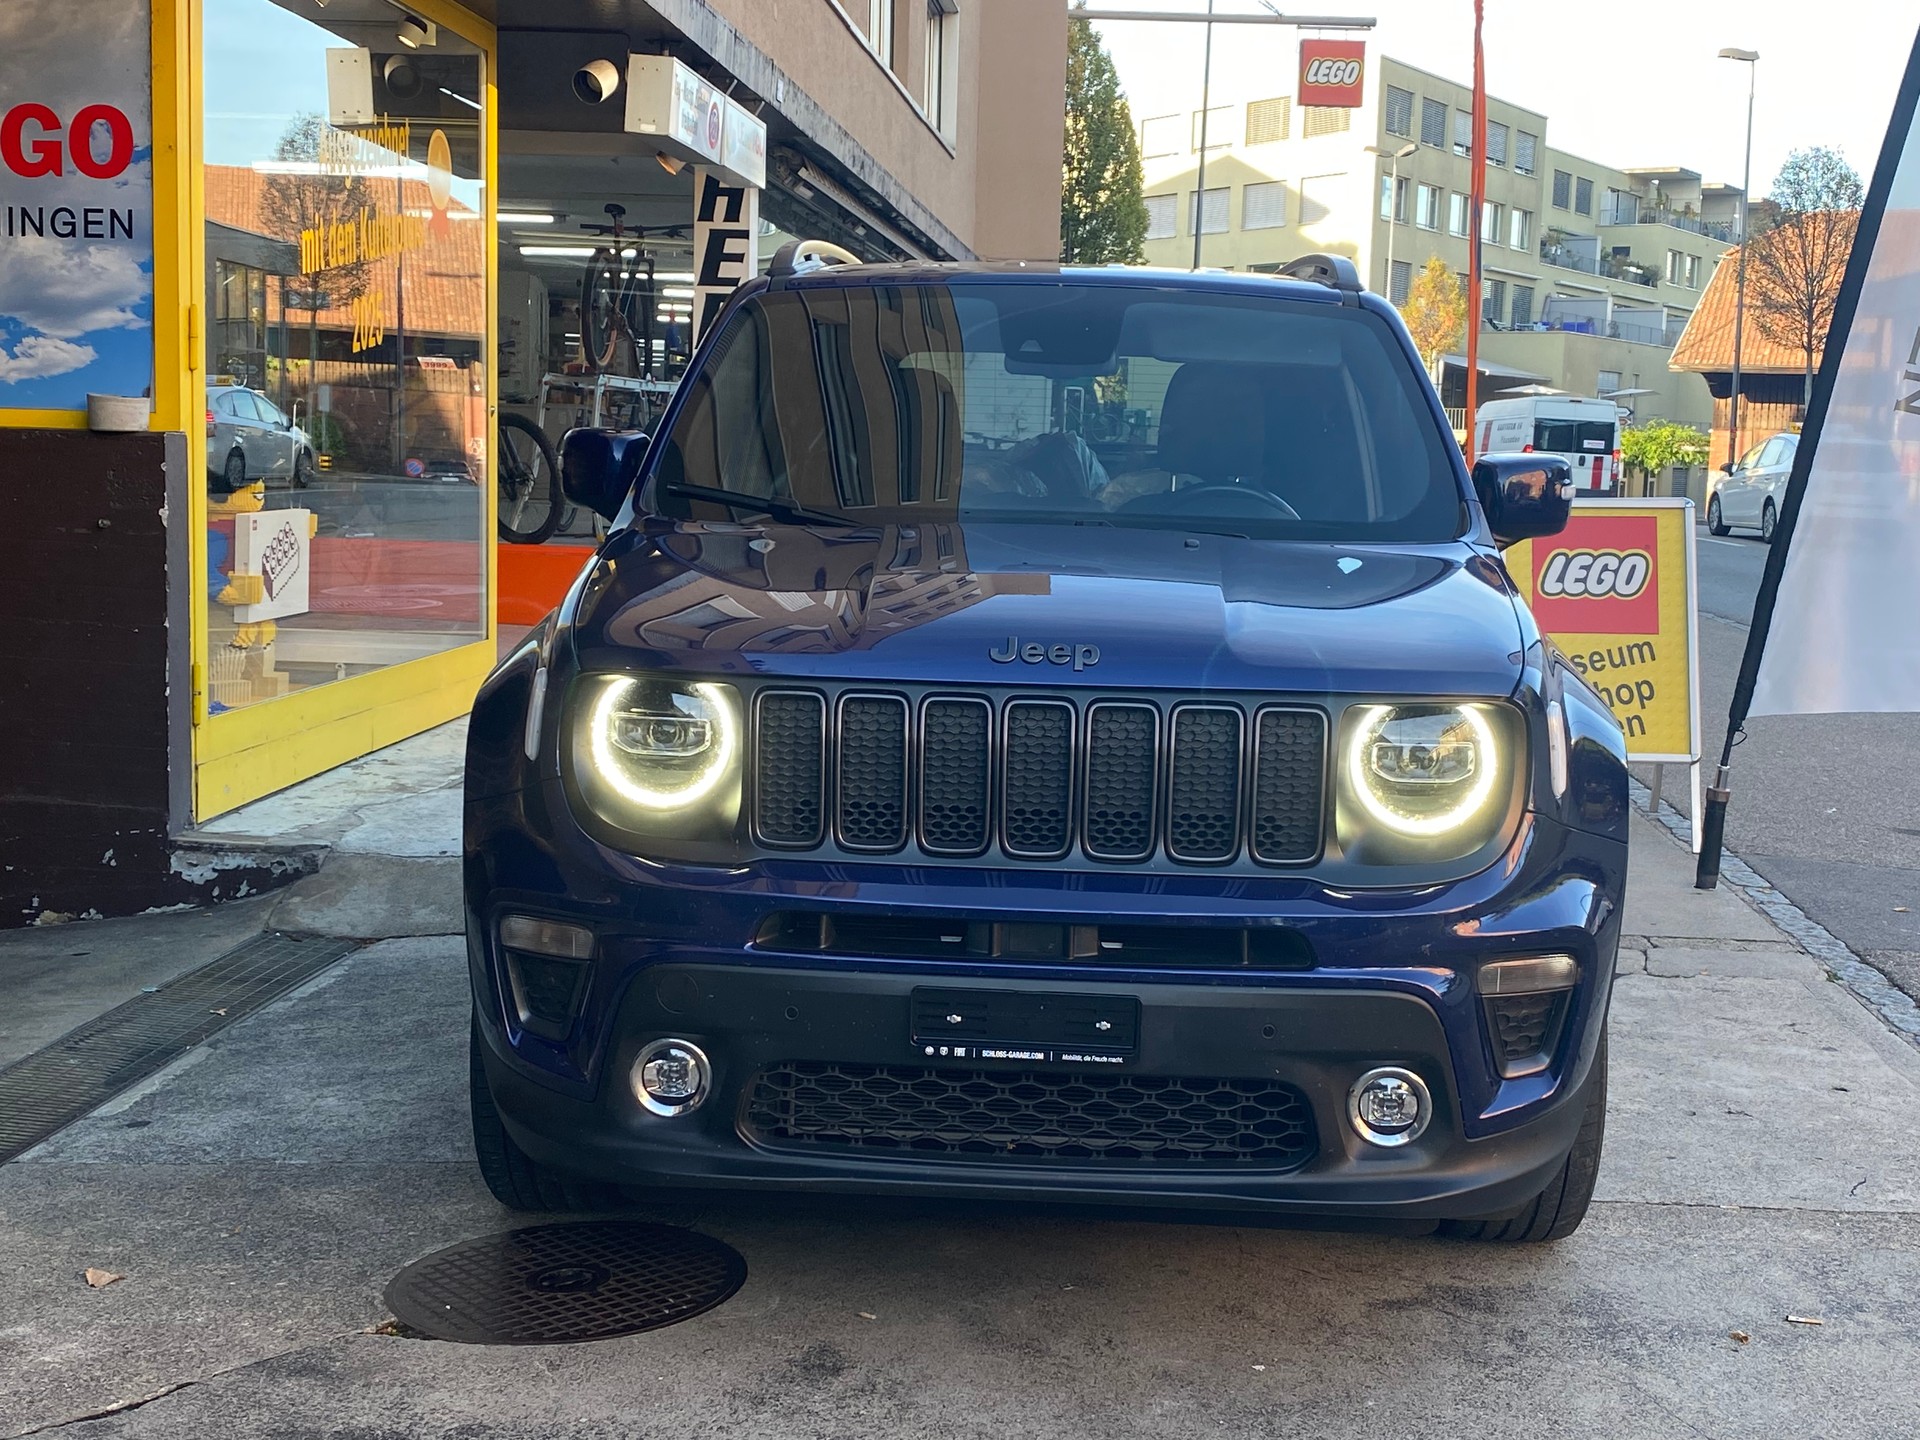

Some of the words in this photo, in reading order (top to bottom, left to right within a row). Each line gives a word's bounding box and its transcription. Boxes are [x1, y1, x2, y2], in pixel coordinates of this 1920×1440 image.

[1306, 58, 1361, 86] LEGO
[1, 103, 133, 179] GO
[0, 206, 133, 239] INGEN
[302, 212, 325, 274] mit
[328, 208, 356, 269] dem
[352, 289, 384, 354] 2025
[1542, 552, 1650, 598] LEGO
[989, 636, 1100, 672] Jeep
[1570, 640, 1656, 675] seum
[982, 1049, 1044, 1061] SCHLOSS-GARAGE.COM
